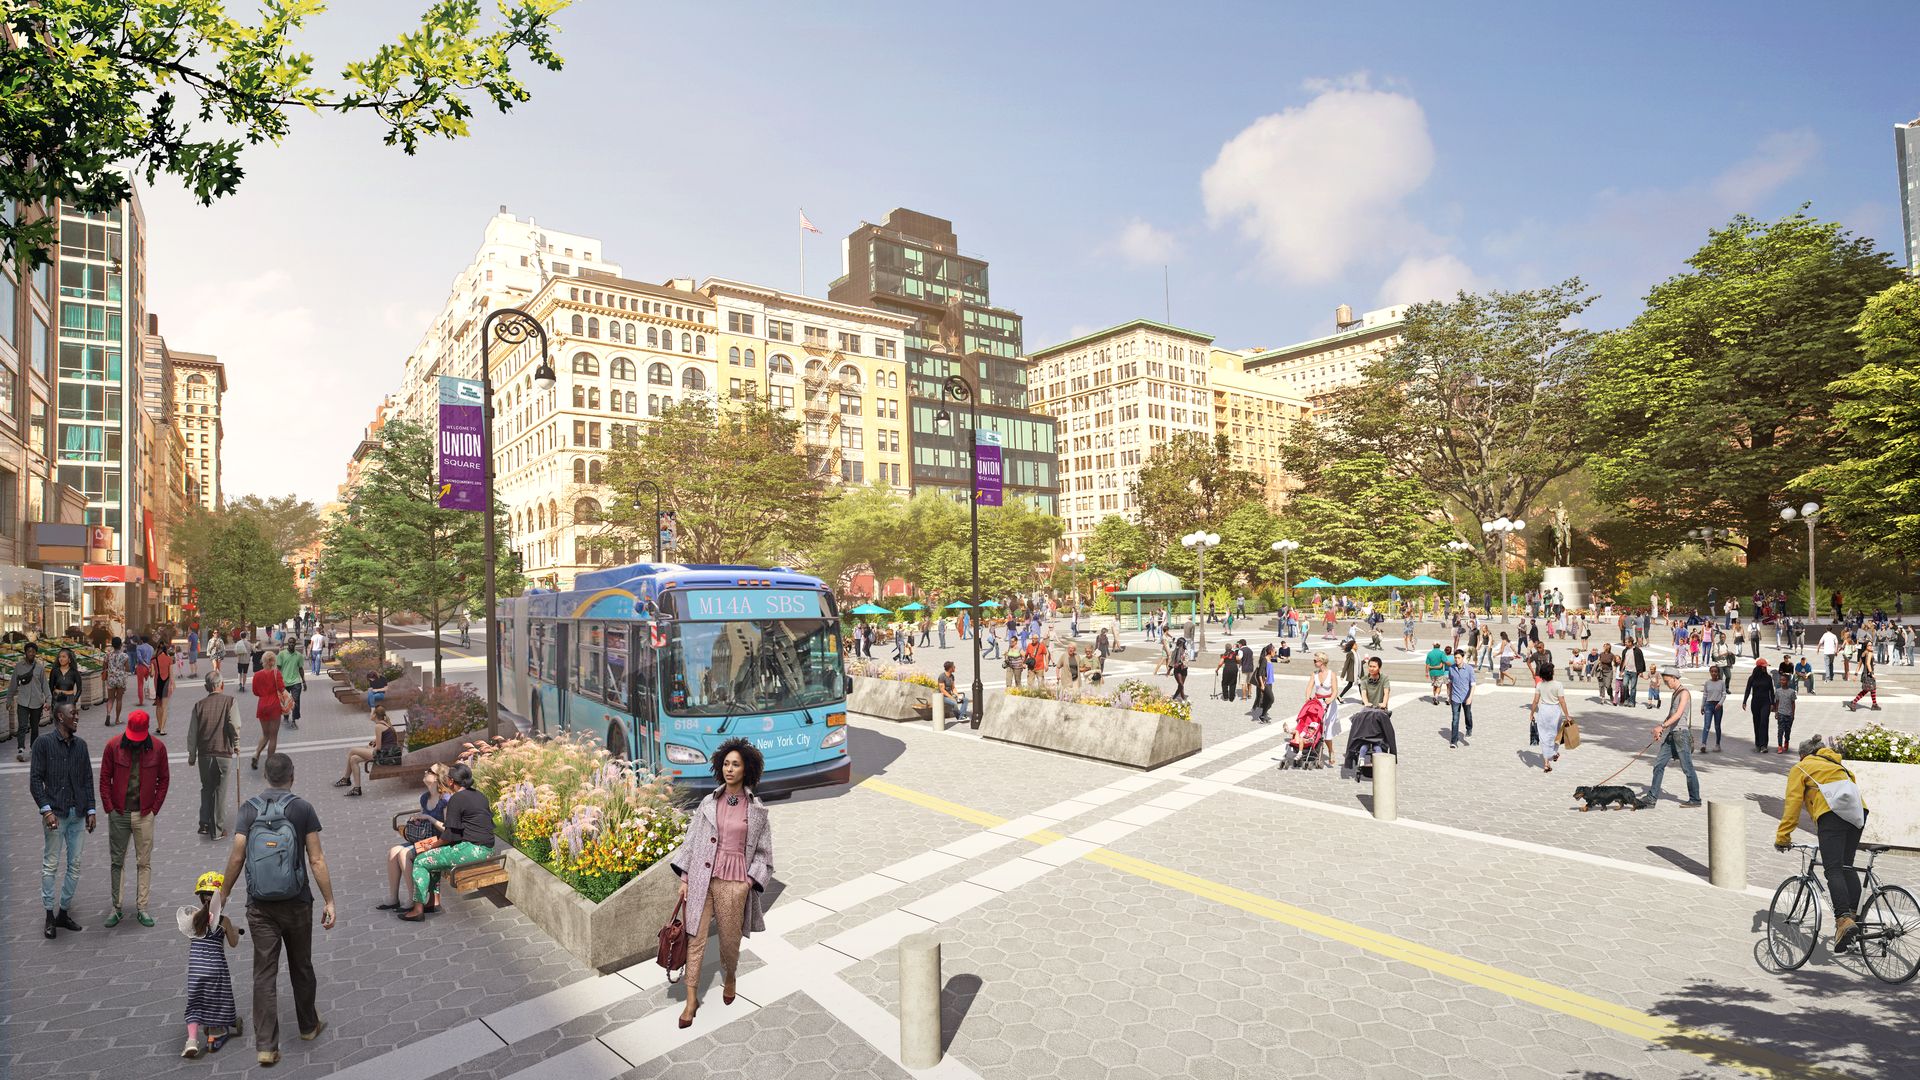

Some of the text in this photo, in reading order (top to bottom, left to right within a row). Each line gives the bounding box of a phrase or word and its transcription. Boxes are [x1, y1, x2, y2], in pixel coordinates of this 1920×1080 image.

[442, 431, 481, 457] UNION
[443, 458, 480, 469] SQUARE
[977, 460, 1000, 475] UNION
[700, 595, 806, 615] M14A SBS
[757, 738, 774, 750] New
[776, 735, 794, 748] York
[796, 733, 811, 747] City
